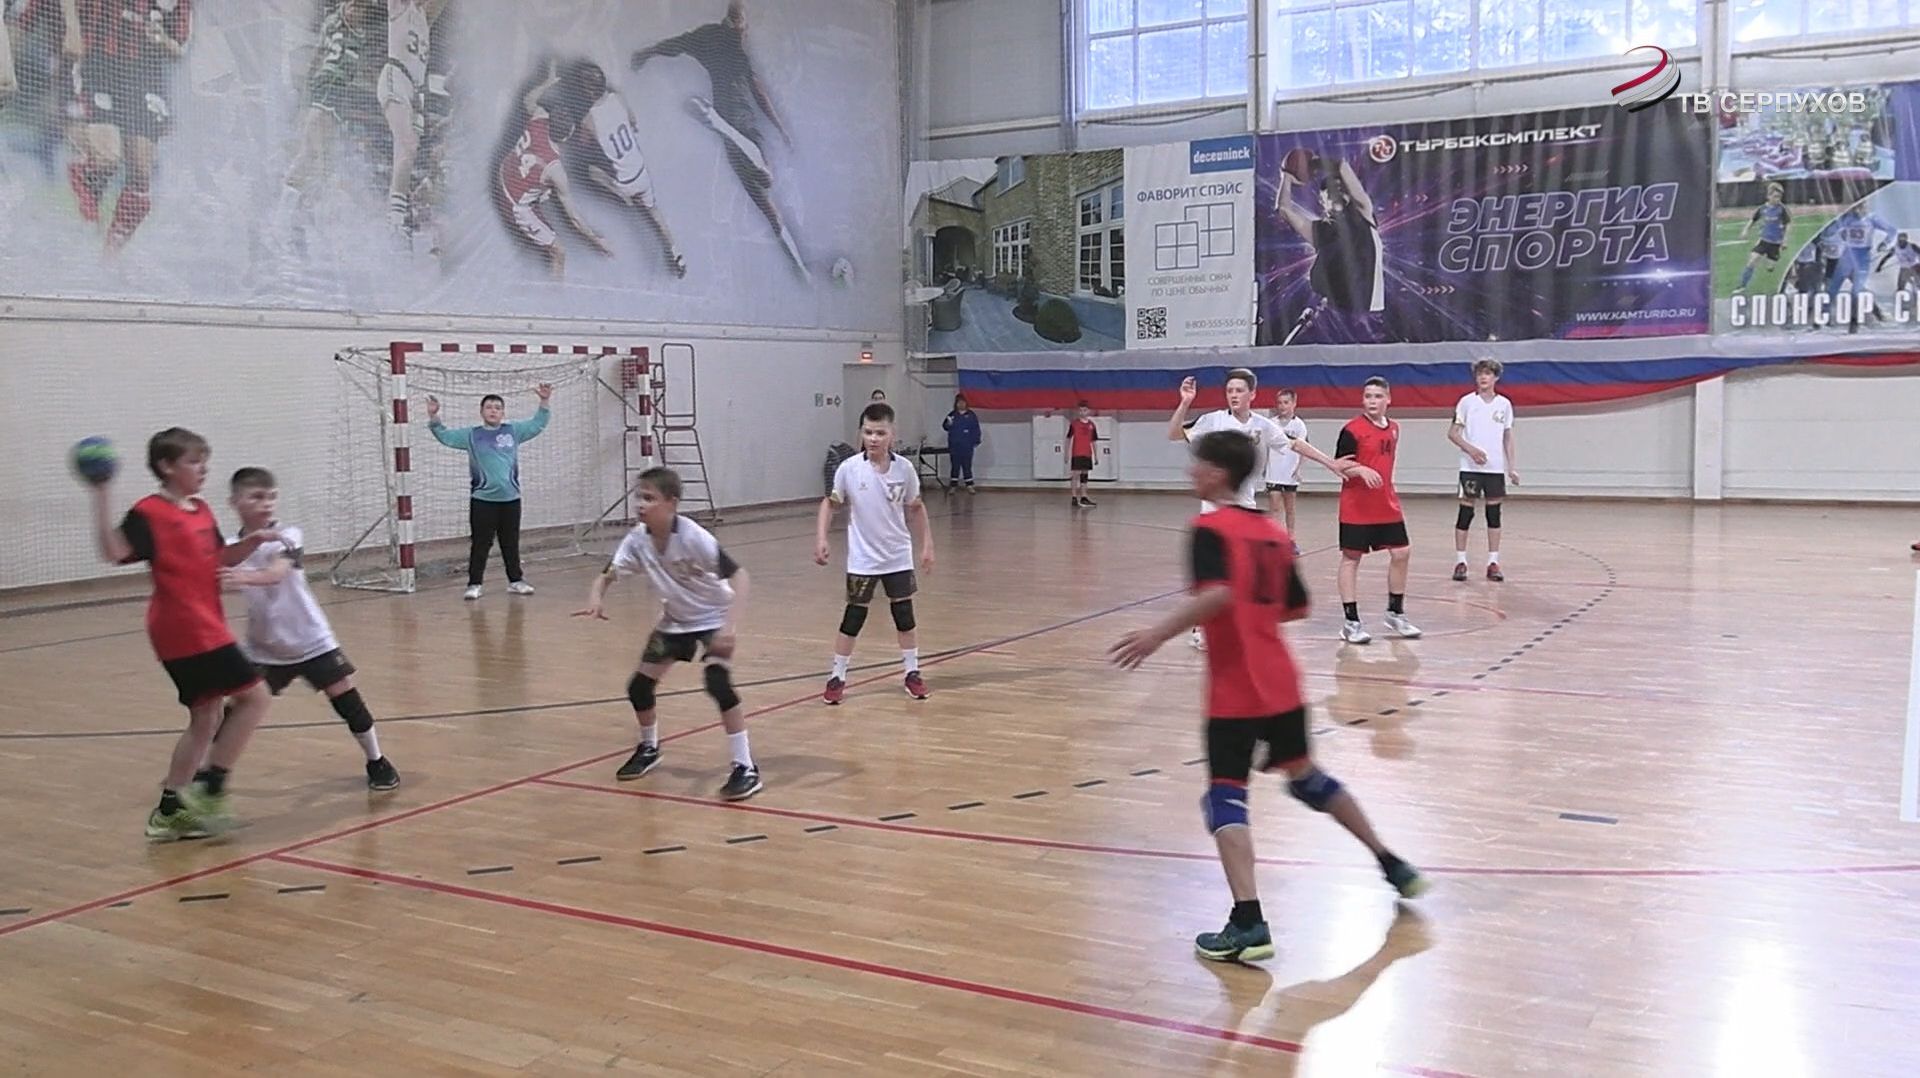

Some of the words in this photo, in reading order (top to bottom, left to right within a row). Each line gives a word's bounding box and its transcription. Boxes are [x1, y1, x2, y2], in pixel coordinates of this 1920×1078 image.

[608, 123, 633, 159] 10
[1400, 124, 1602, 152] ТУРБОКОМПЛЕКТ
[1193, 146, 1251, 164] deceuninck
[1136, 186, 1197, 202] ФАВОРИТ
[1199, 181, 1244, 197] СПЭЙС
[1448, 182, 1679, 234] ЭНЕРГИЯ
[1438, 224, 1670, 273] СПОРТА
[1209, 273, 1233, 281] ОКНА
[1576, 308, 1696, 322] WWW.KAMTURBO.RU
[1731, 290, 1874, 327] СПОНСОР
[1895, 290, 1920, 323] С
